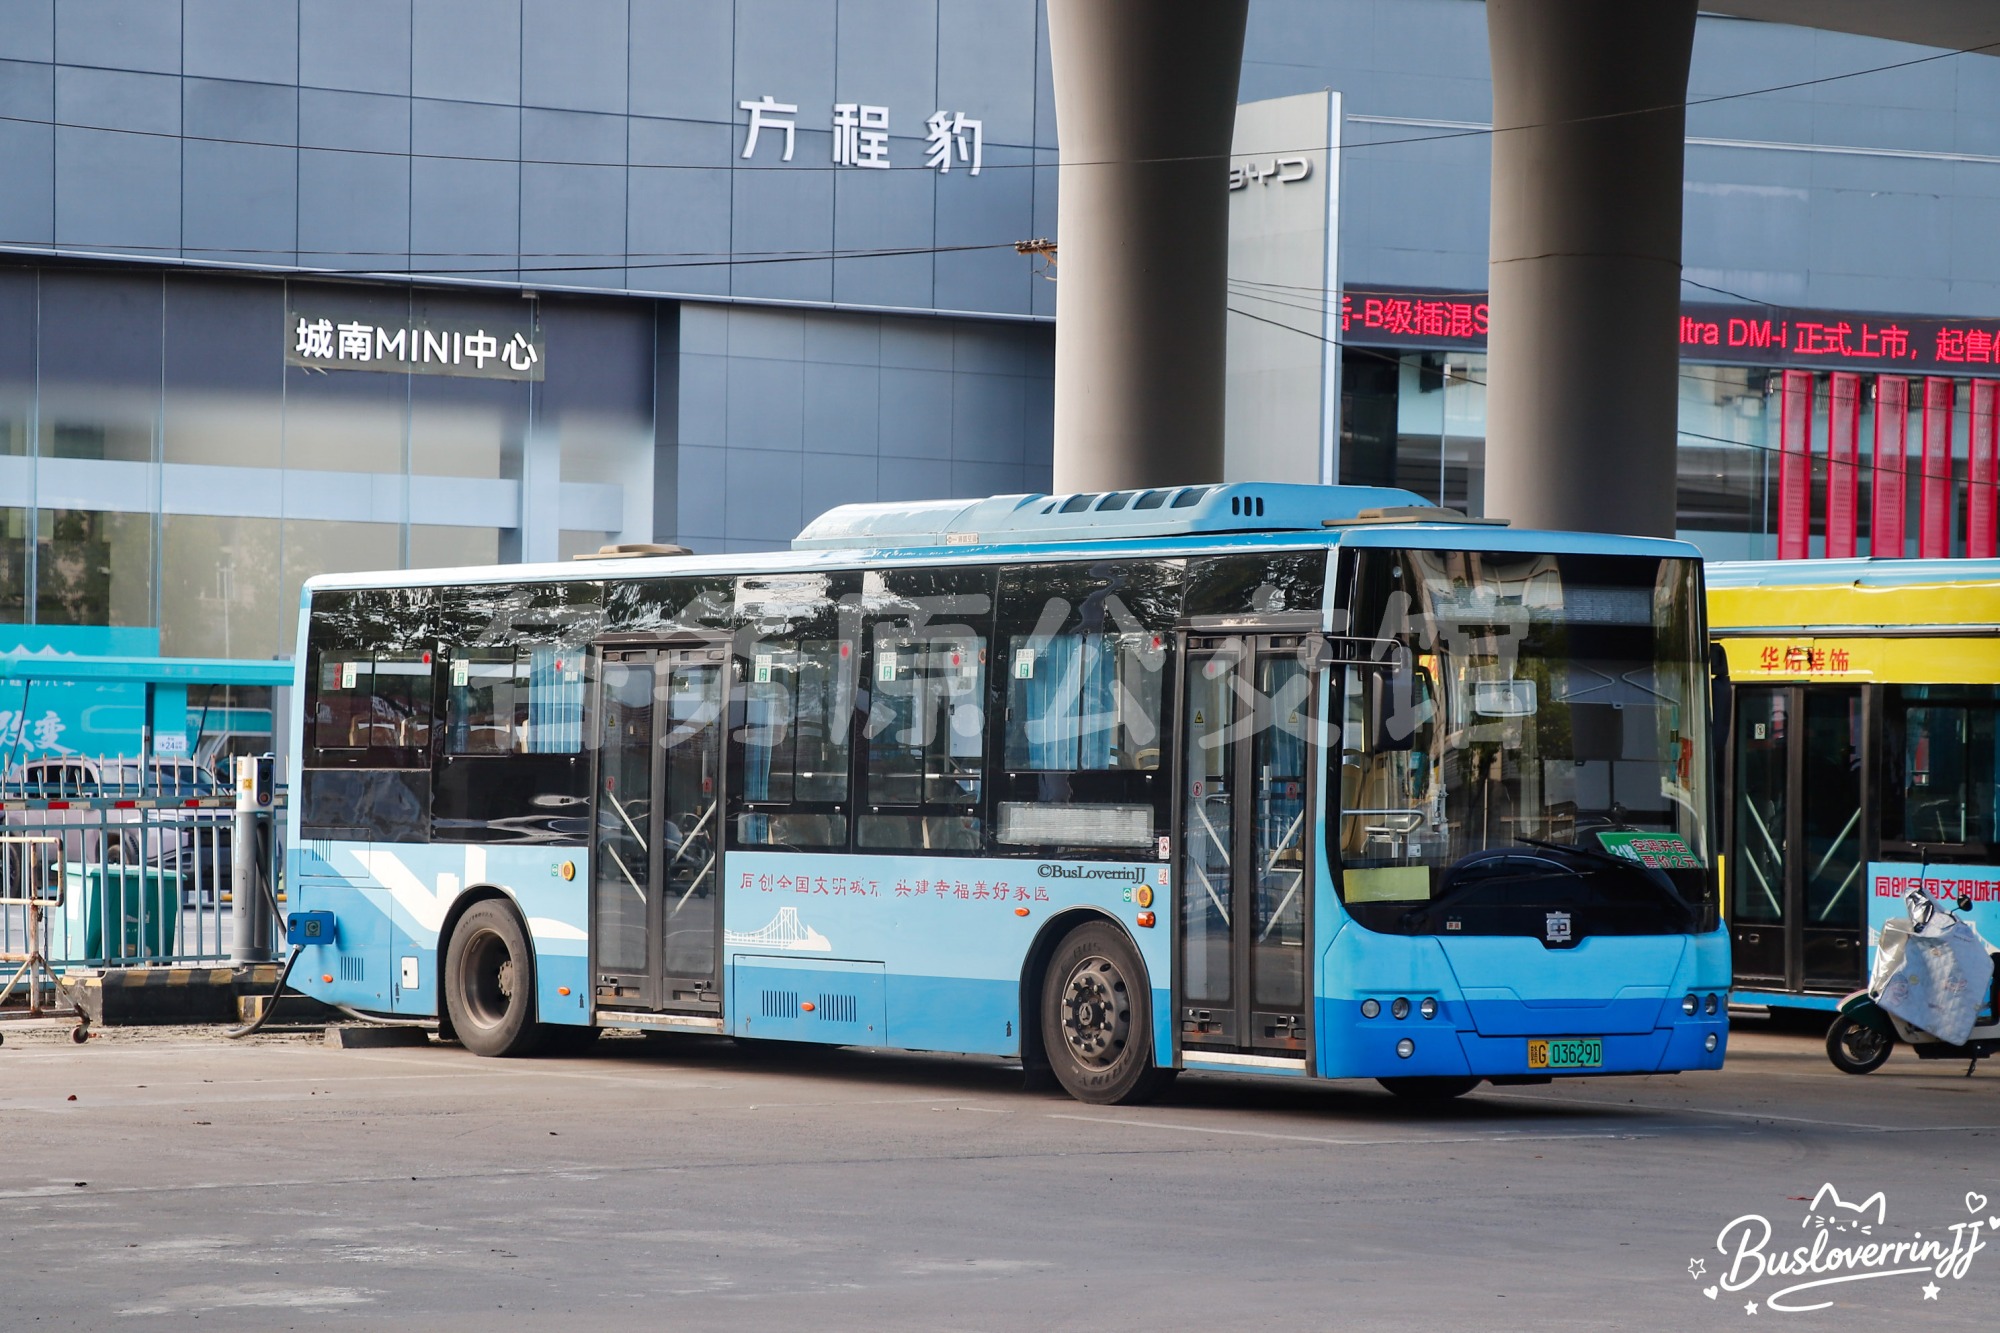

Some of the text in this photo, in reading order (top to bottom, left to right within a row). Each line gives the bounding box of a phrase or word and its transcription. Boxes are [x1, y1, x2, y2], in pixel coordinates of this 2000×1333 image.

[739, 96, 983, 176] 方程豹
[295, 317, 539, 372] 城南MINI中心
[1727, 319, 1787, 349] DM-i
[1630, 839, 1688, 853] 空调开启
[1641, 855, 1699, 869] 票价2元
